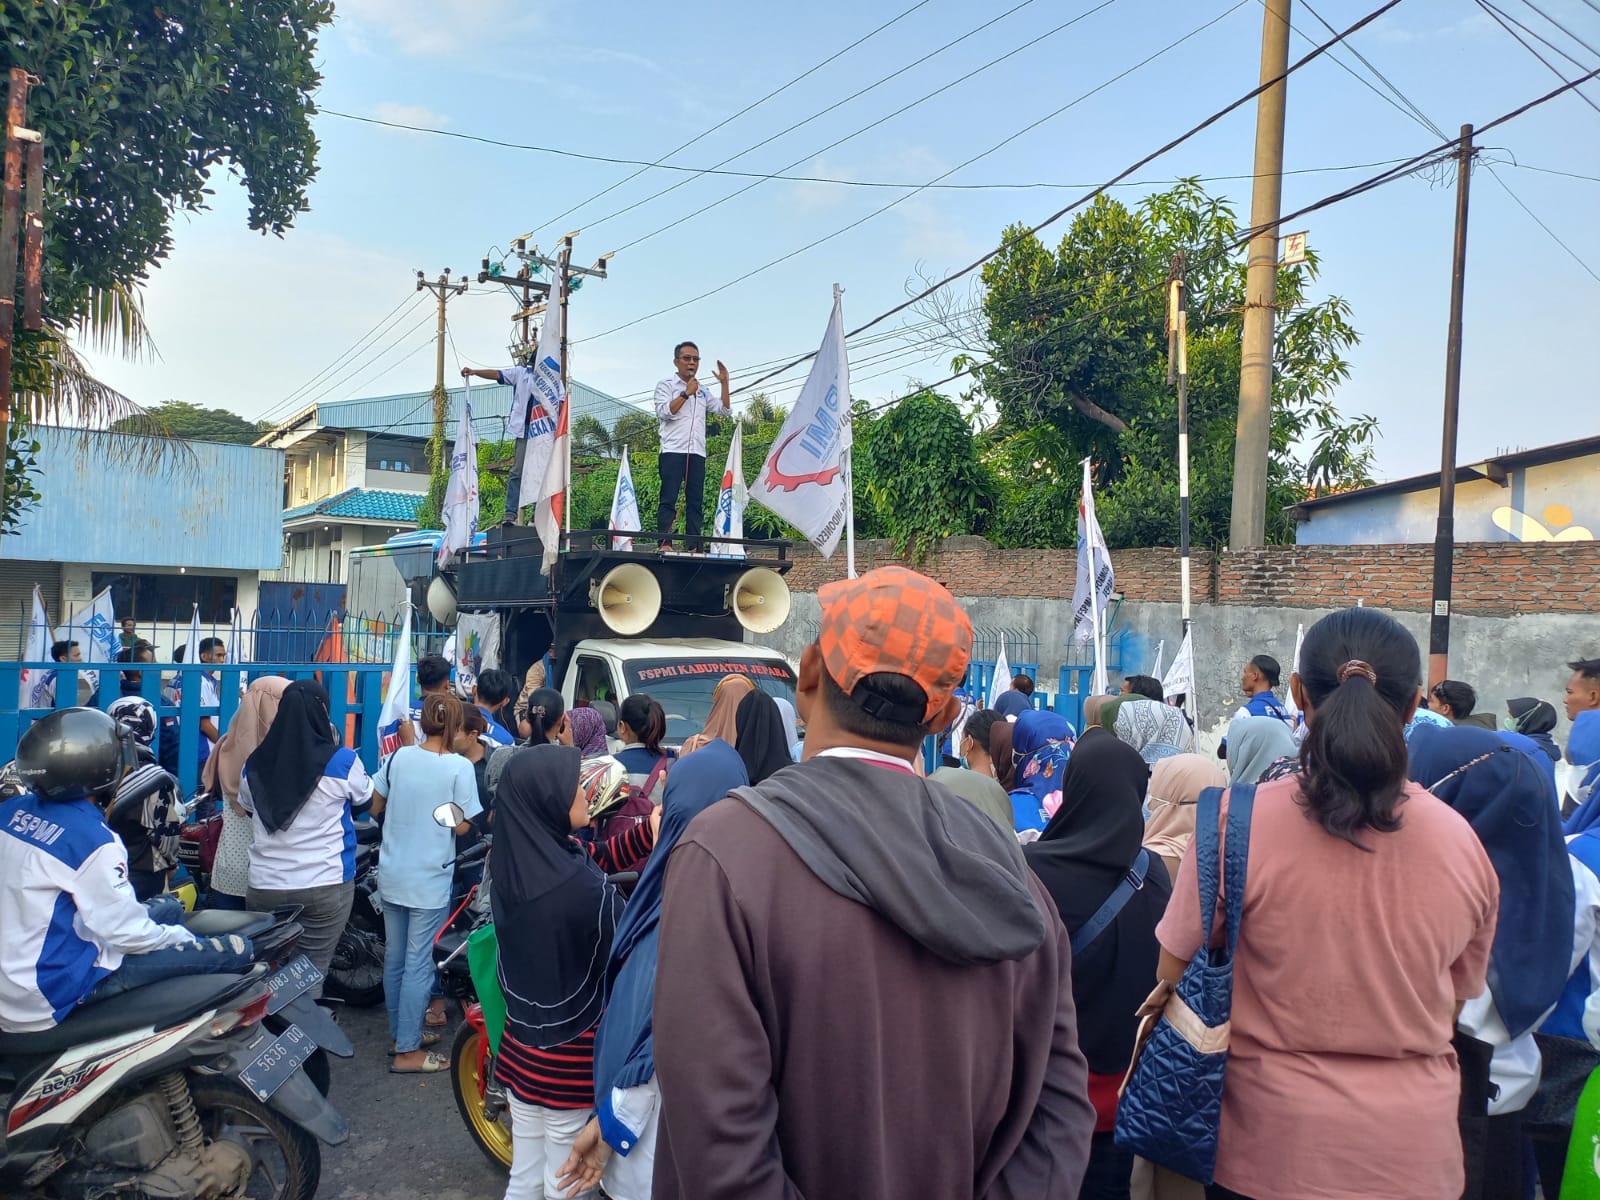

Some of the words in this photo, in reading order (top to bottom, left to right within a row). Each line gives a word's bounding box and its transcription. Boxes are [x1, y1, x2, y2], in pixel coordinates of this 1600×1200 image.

[637, 668, 678, 681] FSPMI
[679, 663, 748, 675] KABUPATEN
[750, 664, 790, 679] JEPARA
[8, 809, 66, 846] FSPMI
[242, 1073, 257, 1087] K
[257, 1042, 288, 1072] 5636
